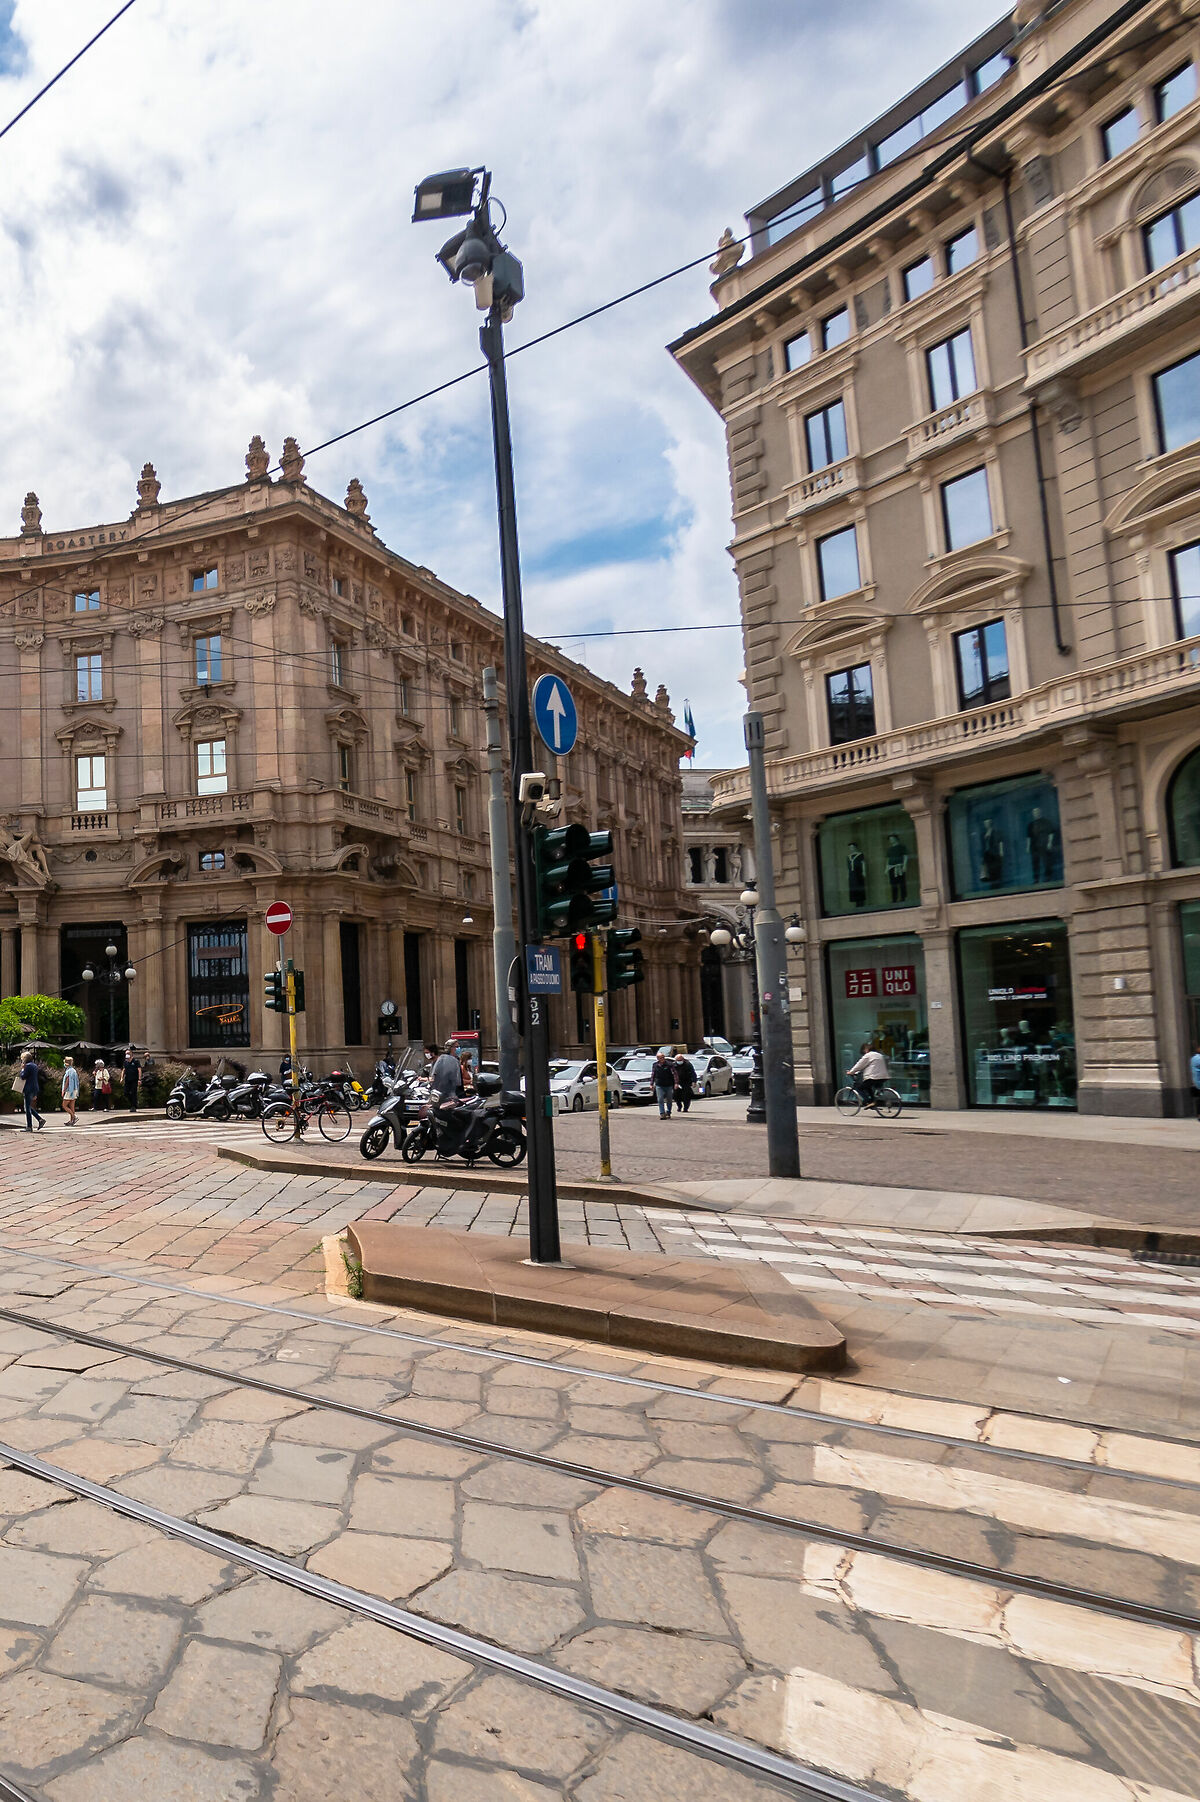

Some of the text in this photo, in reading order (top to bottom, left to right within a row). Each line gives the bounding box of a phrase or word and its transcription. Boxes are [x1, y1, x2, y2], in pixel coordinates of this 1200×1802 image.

[46, 530, 127, 552] ROASTERY
[534, 954, 553, 971] TRAM
[885, 969, 909, 981] UNI
[886, 981, 911, 994] QLO
[531, 1012, 540, 1026] 2
